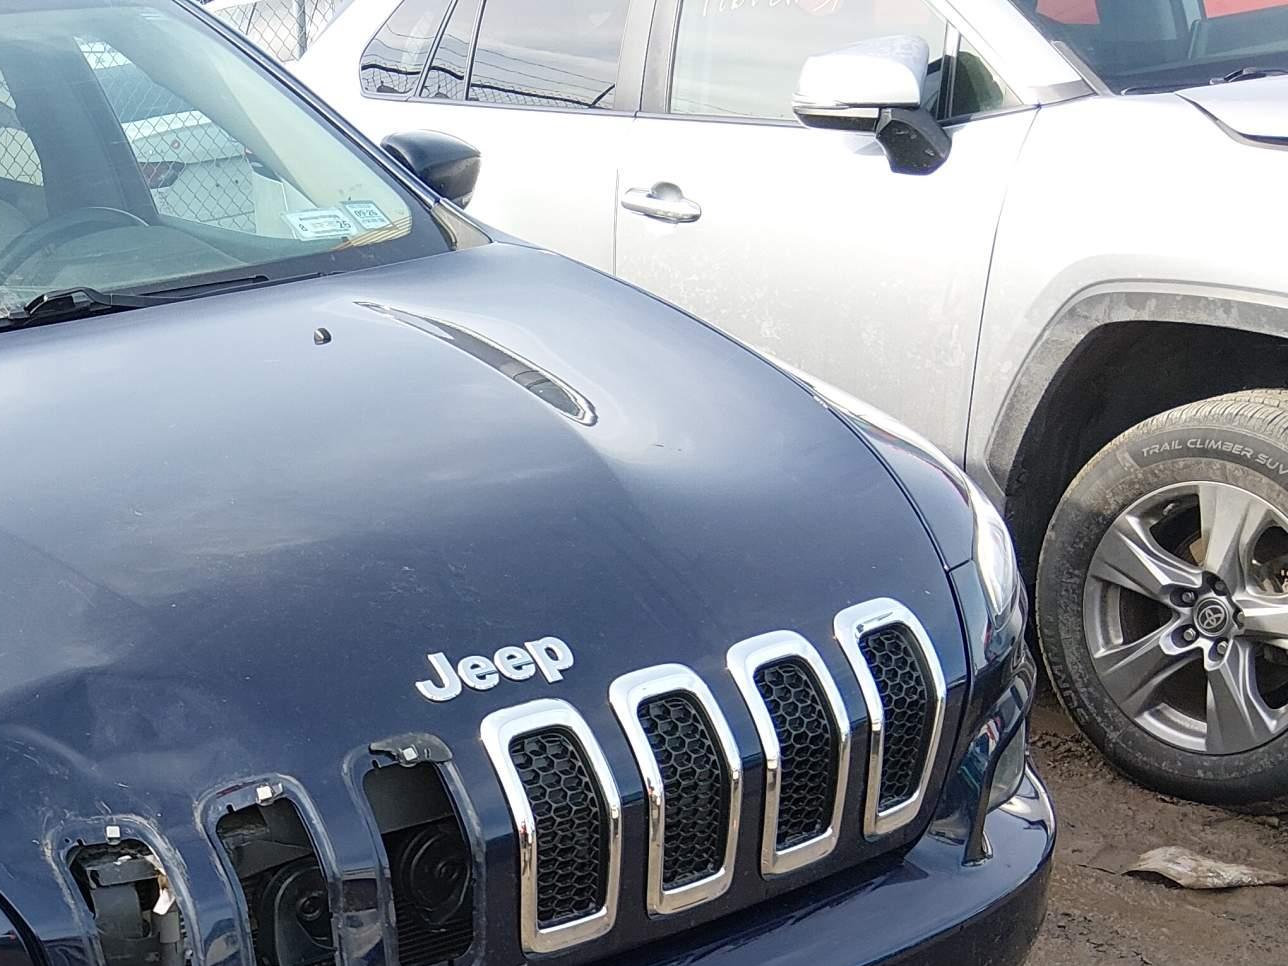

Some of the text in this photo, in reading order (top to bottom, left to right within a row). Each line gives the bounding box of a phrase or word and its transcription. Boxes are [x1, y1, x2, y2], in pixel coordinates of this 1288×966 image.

[1142, 438, 1288, 475] TRAIL CLIMBER SUV
[415, 636, 574, 702] Jeep
